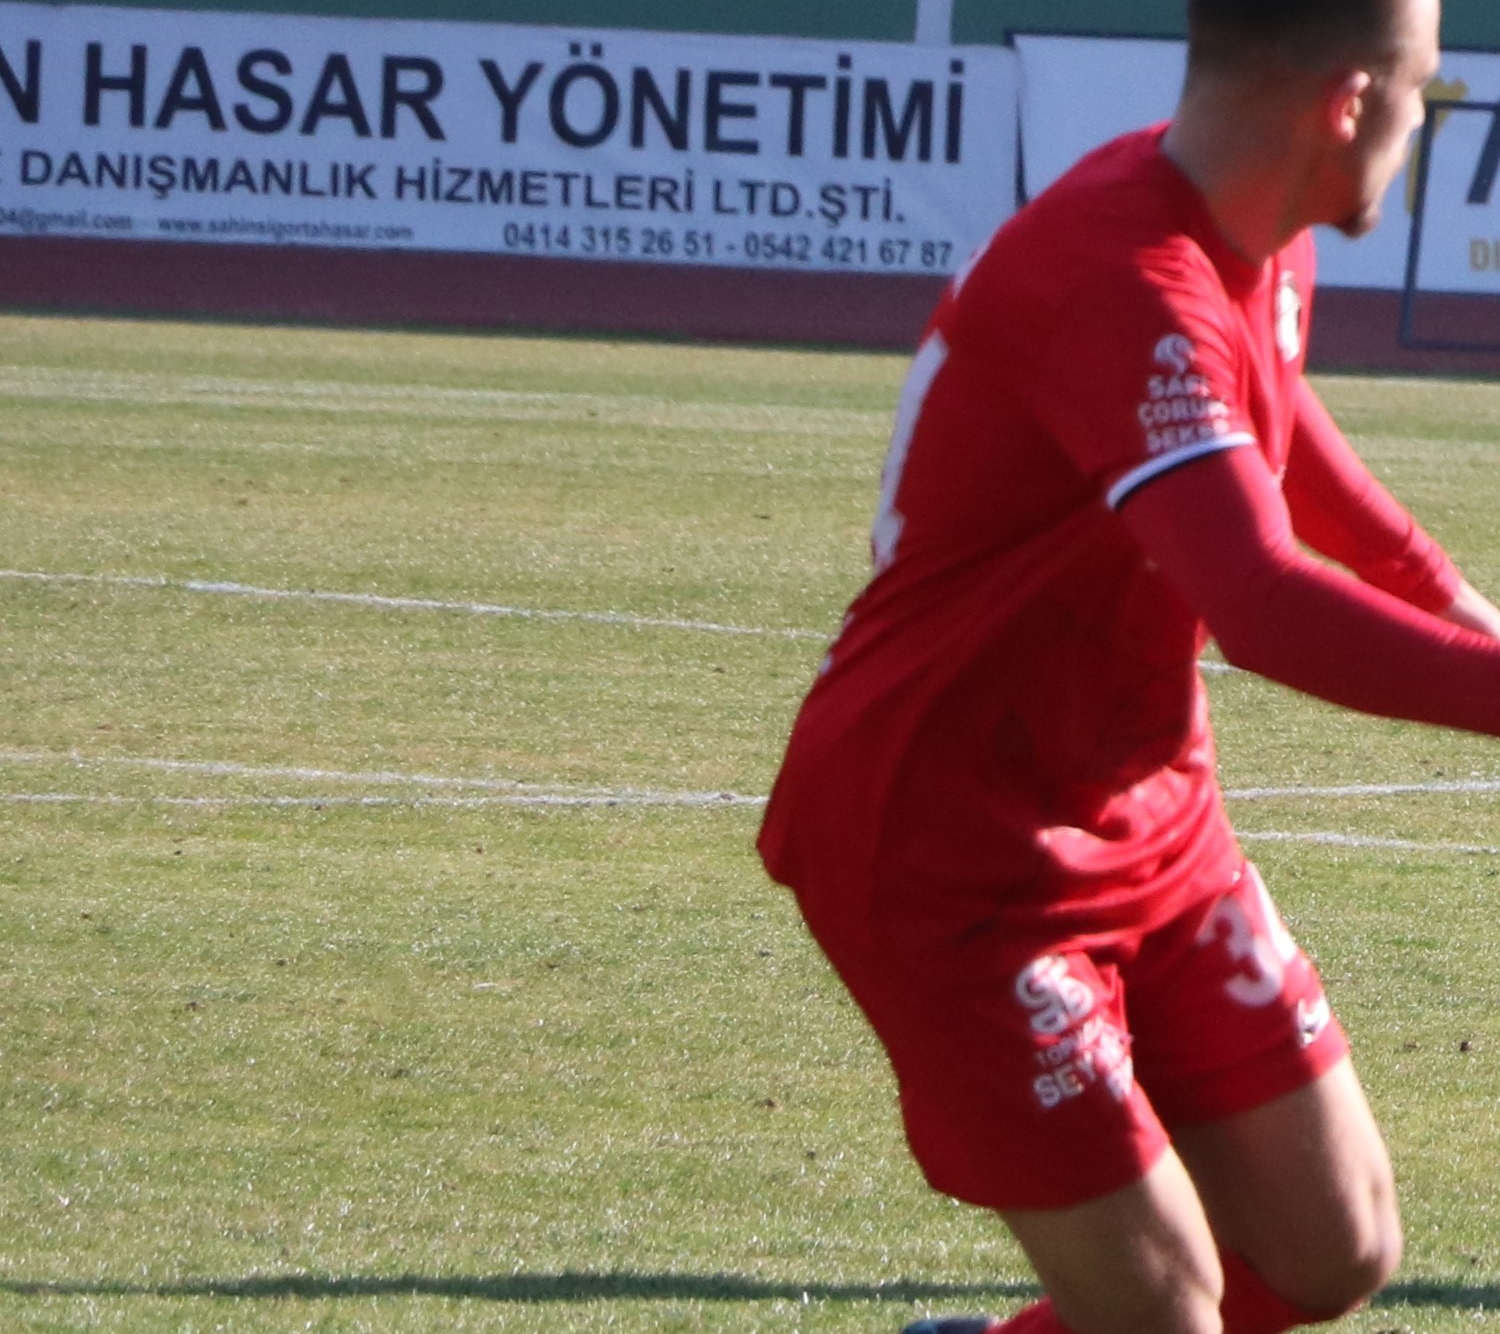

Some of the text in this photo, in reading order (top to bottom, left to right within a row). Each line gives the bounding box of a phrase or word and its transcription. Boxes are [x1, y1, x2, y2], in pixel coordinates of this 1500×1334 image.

[83, 41, 447, 142] HASAR
[478, 41, 965, 165] YÖNETİMİ
[20, 149, 906, 229] DANIŞMANLIK HİZMETLERİ LTD.ŞTİ.
[503, 222, 571, 249] 0414
[579, 225, 631, 255] 315
[641, 229, 674, 256] 26
[683, 231, 715, 258] 51
[743, 232, 812, 263] 0542
[820, 236, 868, 265] 421
[878, 238, 911, 267] 67
[920, 241, 954, 268] 87
